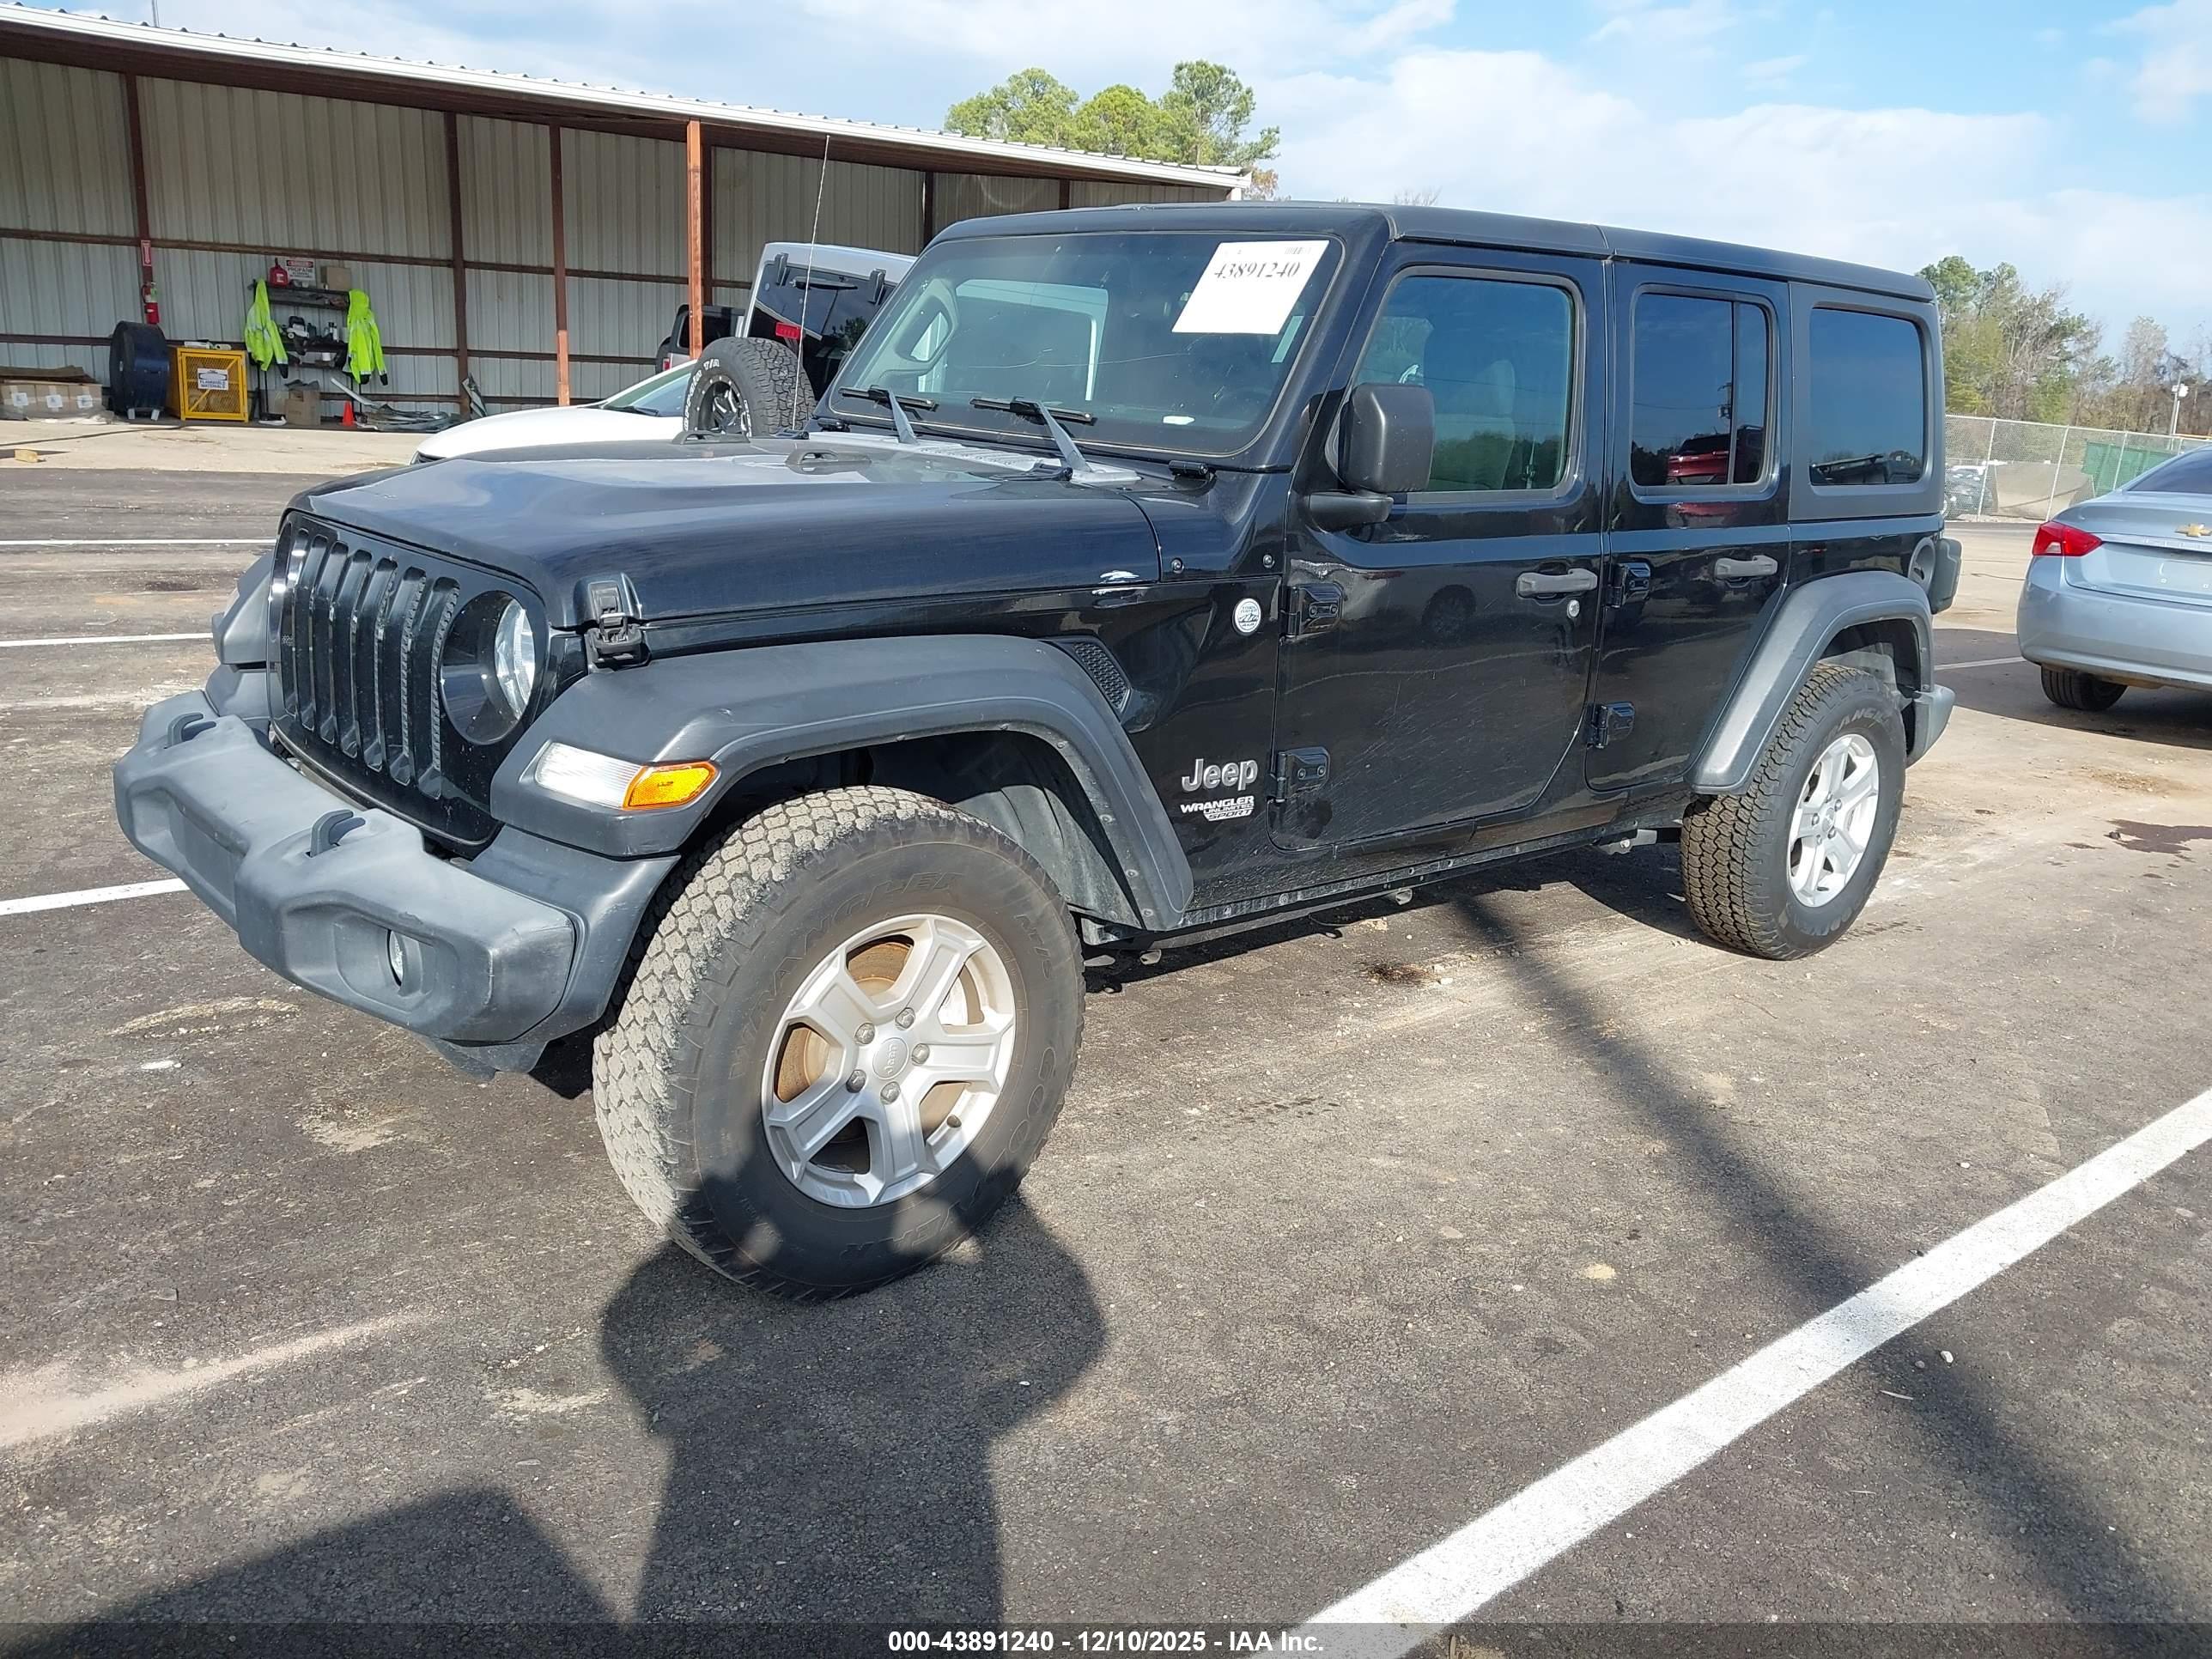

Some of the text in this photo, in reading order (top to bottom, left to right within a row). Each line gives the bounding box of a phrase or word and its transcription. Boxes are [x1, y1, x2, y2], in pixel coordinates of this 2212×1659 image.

[1213, 261, 1301, 279] 43891240
[1181, 758, 1259, 792] Jeep
[1180, 795, 1255, 814] WRANGLER
[1203, 803, 1255, 815] UNLIMITED
[1208, 809, 1252, 820] SPORT
